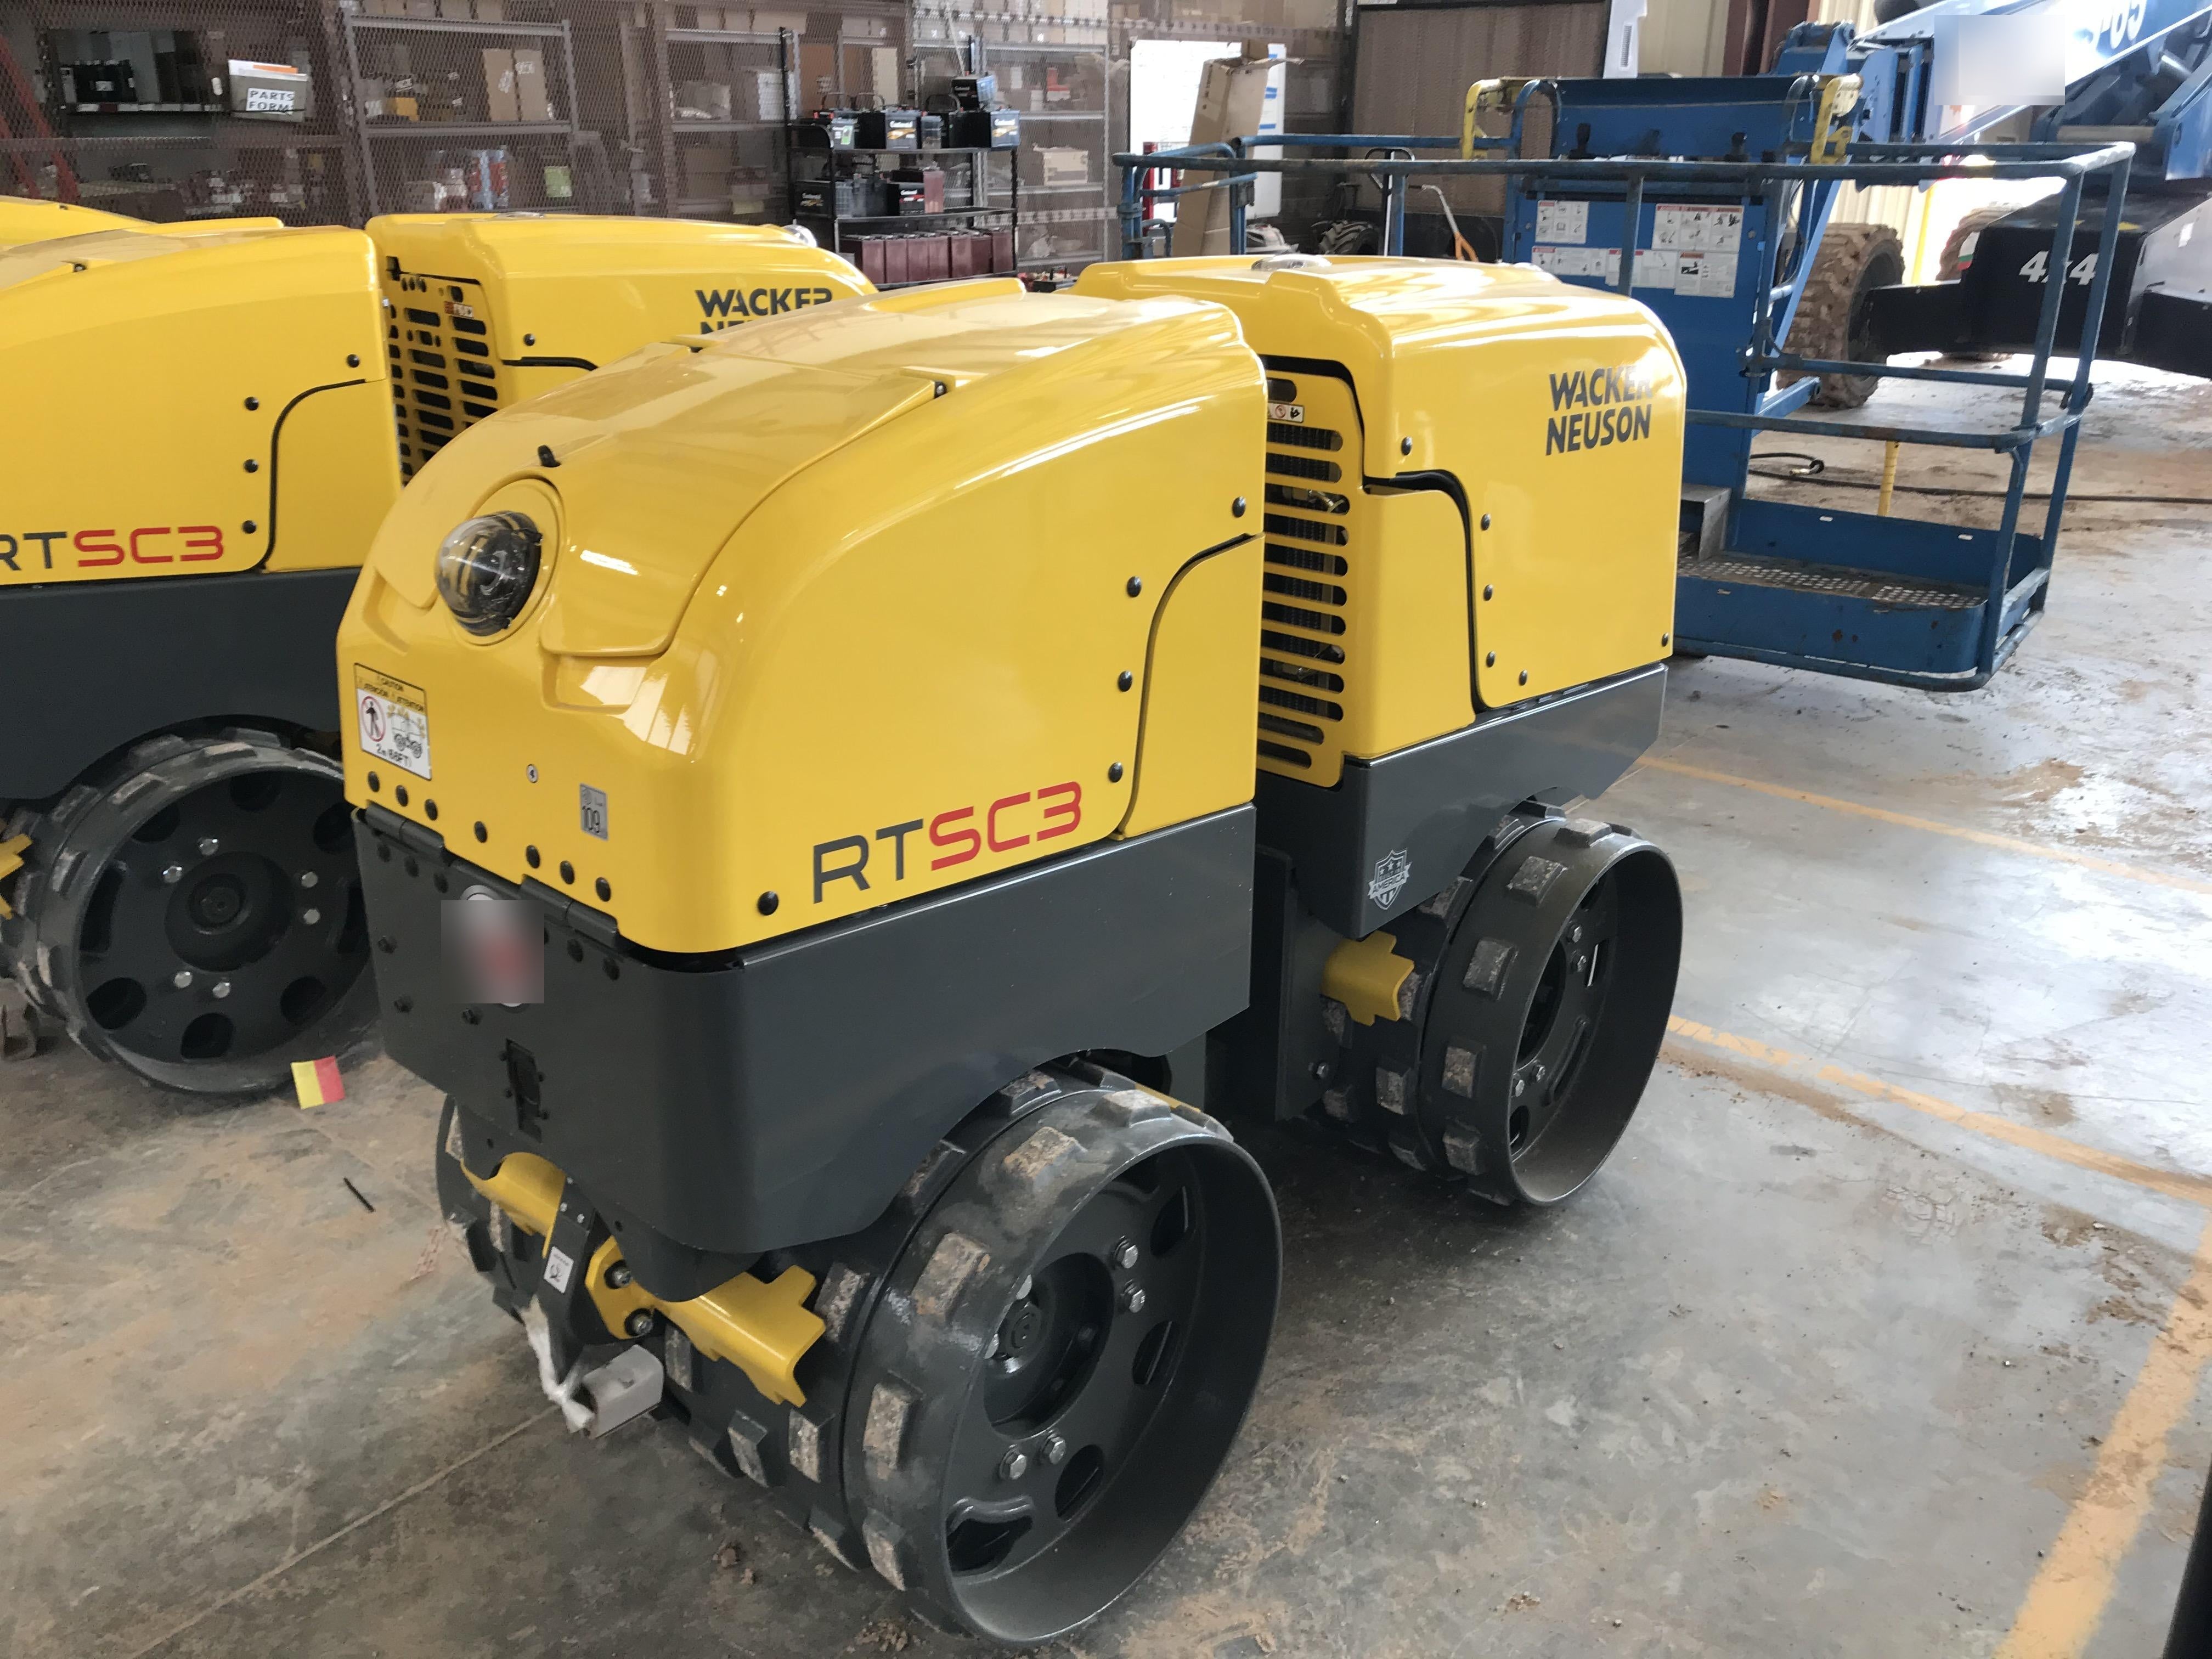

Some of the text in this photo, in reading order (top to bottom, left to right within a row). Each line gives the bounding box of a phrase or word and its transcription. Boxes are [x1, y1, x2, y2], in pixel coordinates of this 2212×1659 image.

[250, 90, 295, 101] PARTS
[1549, 365, 1653, 411] WACKER
[1545, 404, 1652, 456] NEUSON
[813, 781, 1082, 904] RTSC3
